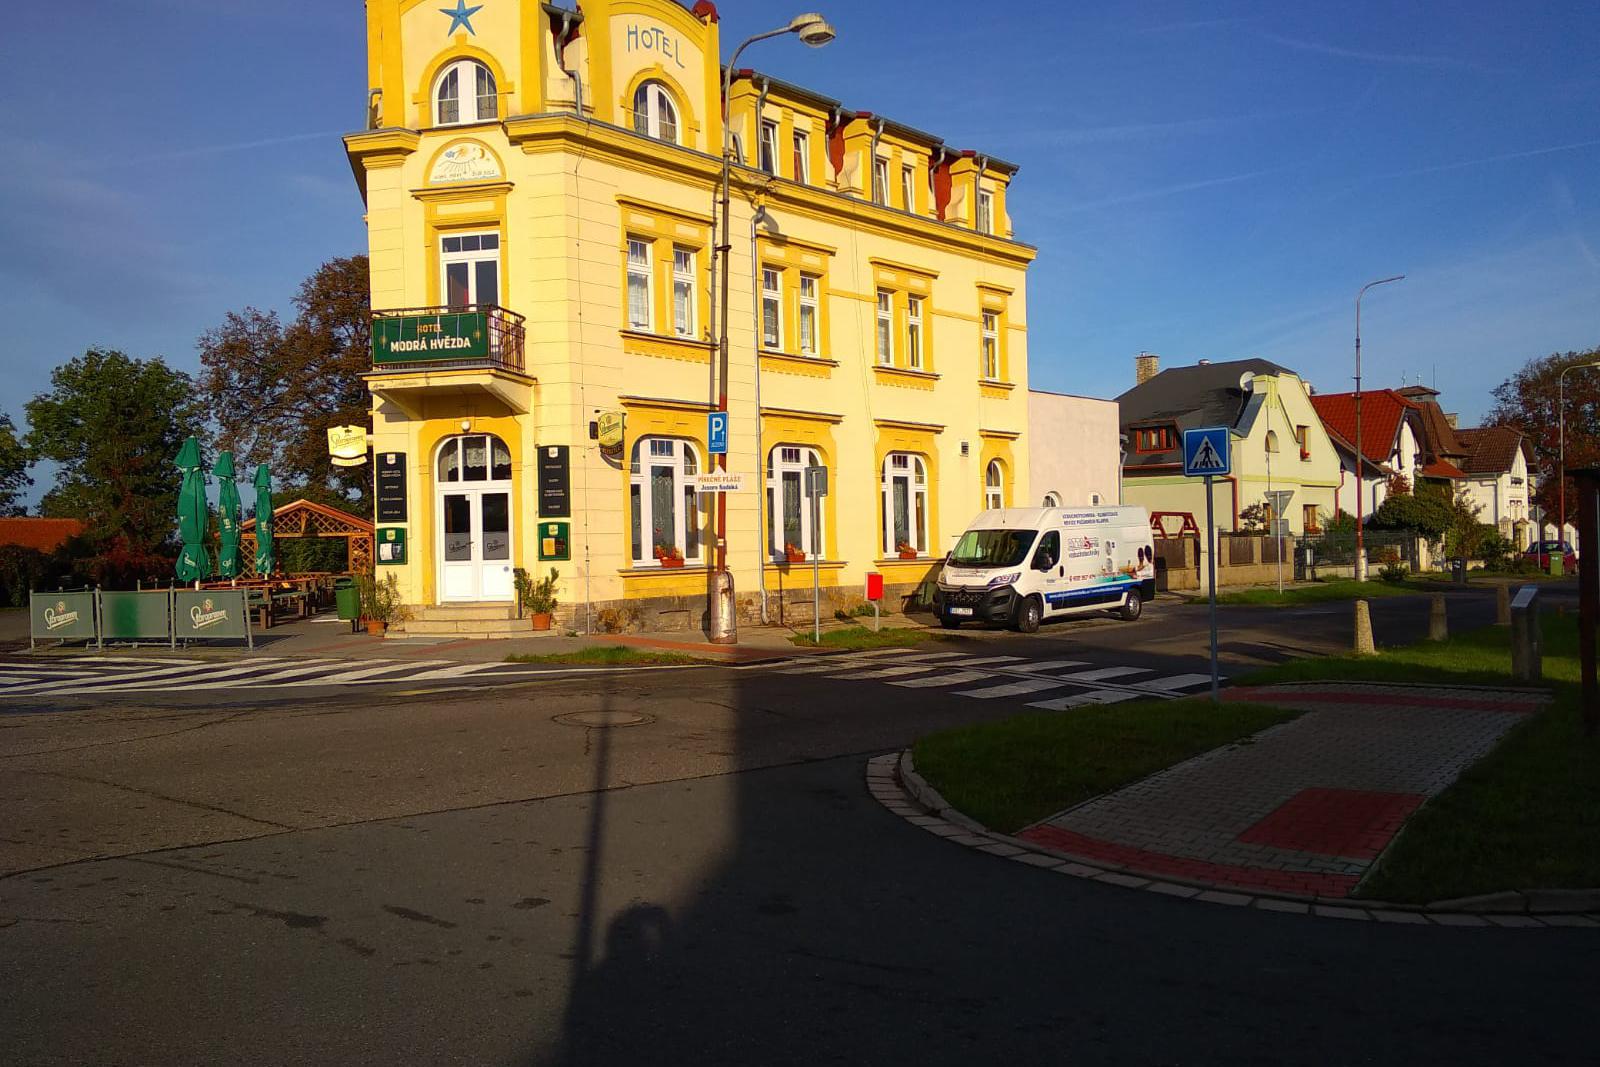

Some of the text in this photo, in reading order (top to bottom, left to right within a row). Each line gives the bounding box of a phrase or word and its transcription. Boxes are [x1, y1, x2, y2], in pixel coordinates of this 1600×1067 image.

[627, 24, 685, 68] HOTEL
[417, 323, 443, 334] HOTEL
[390, 335, 472, 353] MODRÁ HVĚZDA
[712, 417, 724, 441] P
